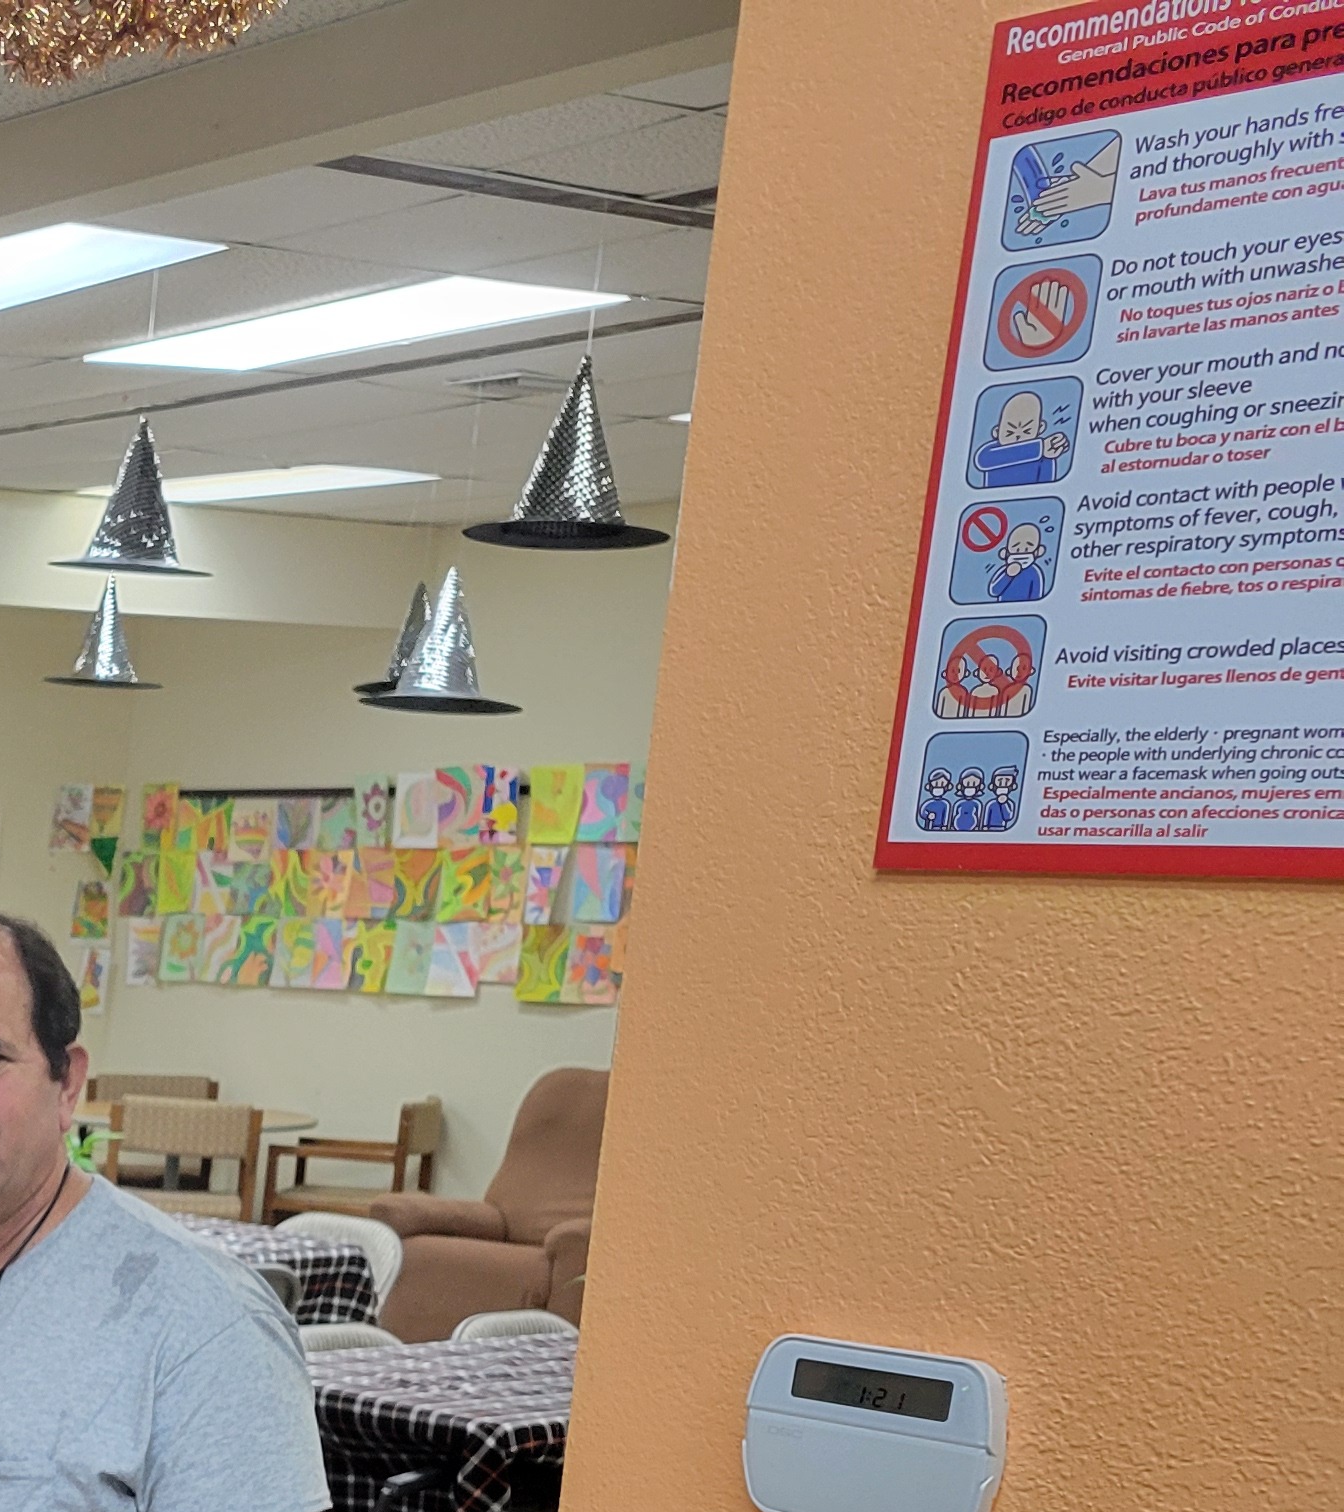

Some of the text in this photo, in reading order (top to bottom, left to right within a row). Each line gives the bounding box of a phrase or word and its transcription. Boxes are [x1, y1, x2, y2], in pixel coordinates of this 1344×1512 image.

[1058, 37, 1128, 64] General
[1133, 27, 1188, 49] Public
[1192, 16, 1241, 36] Code
[1245, 7, 1267, 26] of
[1001, 22, 1344, 104] Recomendaciones para pre
[1071, 99, 1094, 116] de
[1099, 83, 1188, 111] conducta
[1192, 66, 1267, 97] público
[1136, 103, 1344, 154] Wash your hands fre
[1130, 156, 1167, 179] and
[1173, 137, 1284, 172] thoroughly
[1289, 128, 1333, 152] with
[1139, 157, 1344, 202] Lava tus manos frecuent
[1135, 180, 1344, 226] profundamente con agu
[1111, 231, 1344, 277] Do not touch your eyes
[1107, 253, 1344, 301] or mouth with unwashe
[1120, 309, 1143, 323] No
[1147, 300, 1203, 320] toques
[1207, 299, 1232, 311] tus
[1236, 292, 1272, 310] ojos
[1275, 284, 1320, 302] nariz
[1322, 283, 1334, 295] o
[1116, 304, 1340, 343] sin lavarte las manos antes
[1096, 367, 1153, 385] Cover
[1155, 361, 1203, 384] your
[1207, 349, 1273, 373] mouth
[1279, 342, 1320, 364] and
[1093, 380, 1253, 410] with your sleeve
[1089, 414, 1140, 434] when
[1146, 404, 1238, 429] coughing
[1243, 403, 1266, 418] or
[1104, 439, 1152, 454] Cubre
[1156, 436, 1172, 449] tu
[1176, 432, 1216, 447] boca
[1220, 430, 1231, 446] y
[1233, 425, 1276, 441] nariz
[1280, 423, 1310, 437] con
[1315, 418, 1331, 433] el
[1101, 460, 1116, 473] al
[1213, 452, 1223, 463] o
[1227, 448, 1271, 461] toser
[1077, 490, 1132, 512] Avoid
[1136, 486, 1210, 507] contact
[1216, 480, 1258, 500] with
[1263, 474, 1335, 501] people
[1074, 499, 1338, 539] symptoms of fever, cough,
[1070, 541, 1122, 559] other
[1126, 534, 1235, 557] respiratory
[1084, 568, 1123, 582] Evite
[1126, 566, 1140, 580] el
[1144, 562, 1216, 579] contacto
[1219, 561, 1249, 574] con
[1253, 557, 1333, 575] personas
[1157, 582, 1177, 597] de
[1181, 580, 1234, 595] fiebre,
[1238, 581, 1263, 593] tos
[1267, 580, 1278, 591] o
[1281, 575, 1344, 590] respira
[1055, 637, 1344, 664] Avoid visiting crowded places
[1068, 675, 1106, 688] Evite
[1110, 673, 1159, 687] visitar
[1161, 671, 1222, 688] lugares
[1226, 669, 1276, 683] llenos
[1280, 667, 1301, 681] de
[1043, 728, 1120, 746] Especially,
[1125, 728, 1151, 742] the
[1154, 727, 1209, 744] elderly
[1222, 727, 1300, 745] pregnant
[1051, 748, 1076, 762] the
[1078, 748, 1130, 764] people
[1134, 747, 1166, 761] with
[1170, 746, 1257, 763] underlying
[1260, 745, 1323, 759] chronic
[1037, 769, 1074, 780] must
[1079, 769, 1116, 780] wear
[1119, 770, 1128, 780] a
[1132, 766, 1207, 780] facemask
[1211, 765, 1255, 780] when
[1259, 766, 1307, 782] going
[1040, 805, 1067, 818] das
[1070, 808, 1080, 819] o
[1082, 807, 1155, 821] personas
[1159, 808, 1187, 818] con
[1191, 804, 1279, 819] afecciones
[1043, 787, 1344, 802] Especialmente ancianos, mujeres em
[1038, 824, 1208, 838] usar mascarilla al salir
